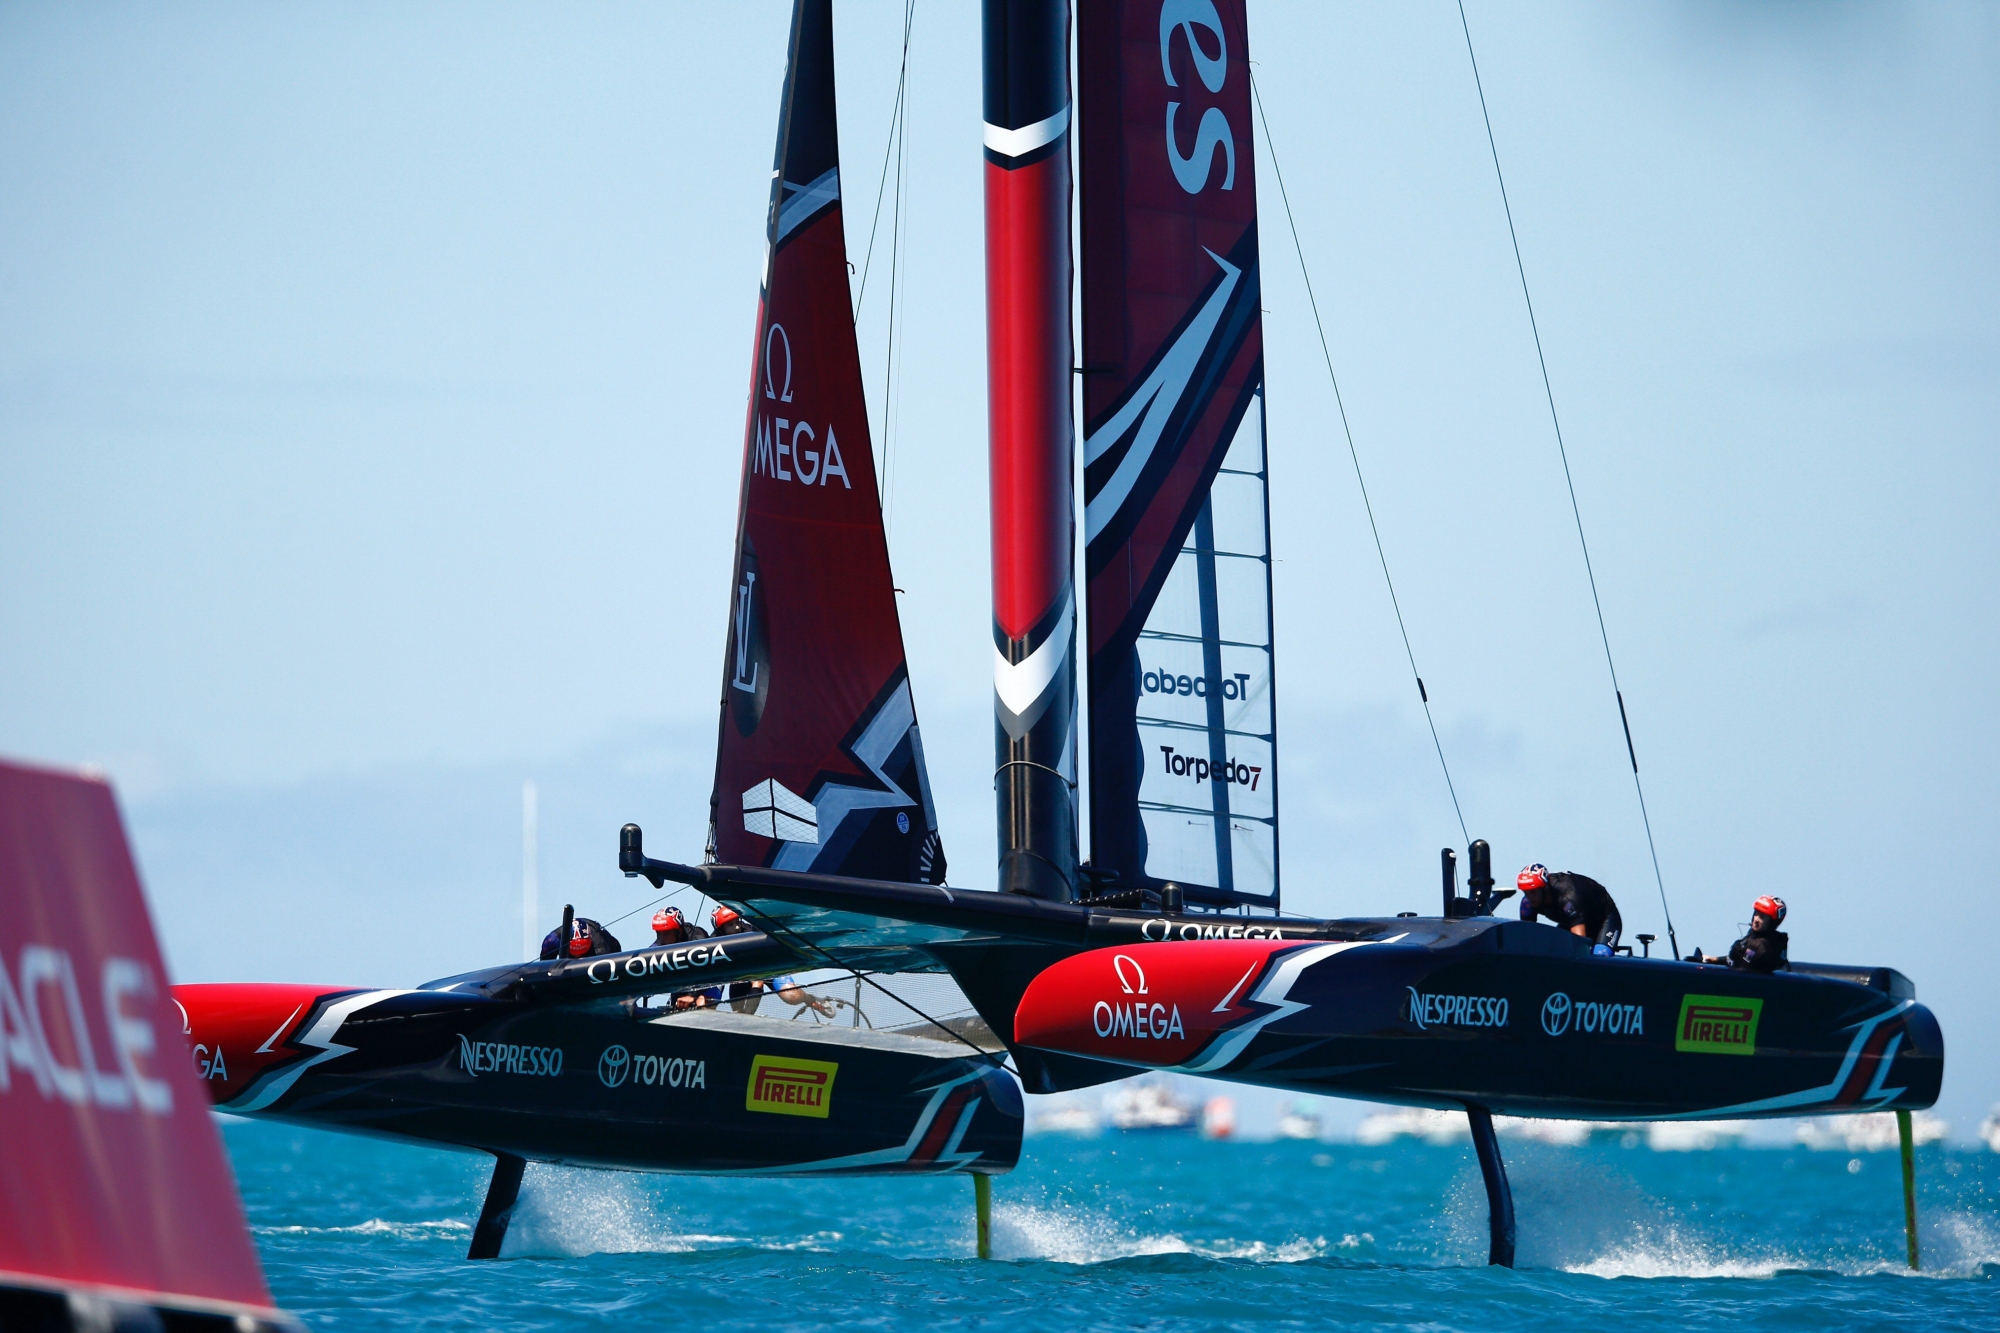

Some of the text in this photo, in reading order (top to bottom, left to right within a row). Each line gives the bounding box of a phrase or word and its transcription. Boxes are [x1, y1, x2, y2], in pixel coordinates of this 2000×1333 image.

[753, 412, 851, 489] MEGA
[1160, 745, 1262, 792] Torpedo7
[1180, 923, 1283, 941] OMEGA
[625, 943, 733, 977] OMEGA
[1093, 1000, 1185, 1040] OMEGA
[1406, 986, 1508, 1029] NESPRESSO
[1574, 1002, 1644, 1035] TOYOTA
[1682, 1006, 1754, 1045] PIRELLI
[0, 946, 174, 1117] ACLE
[456, 1033, 564, 1077] NESPRESSO
[633, 1054, 706, 1090] TOYOTA
[753, 1066, 828, 1107] PIRELLI
